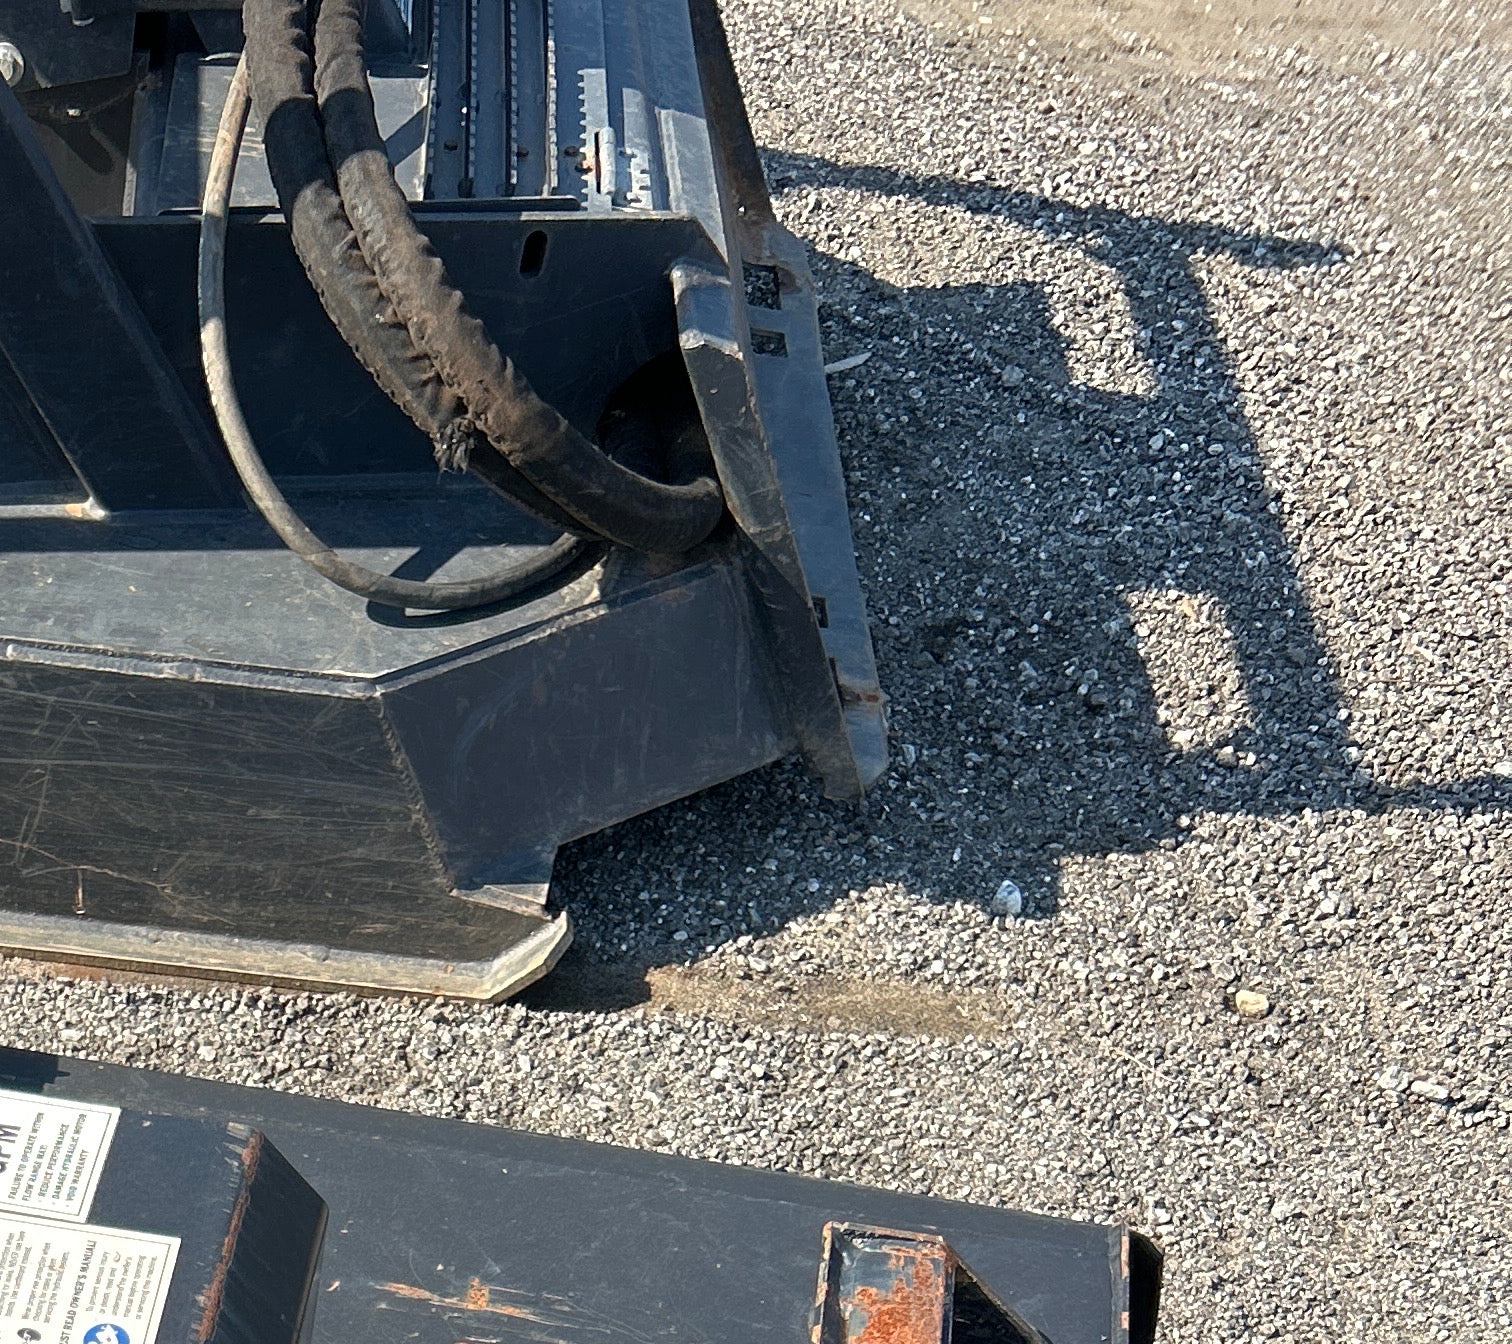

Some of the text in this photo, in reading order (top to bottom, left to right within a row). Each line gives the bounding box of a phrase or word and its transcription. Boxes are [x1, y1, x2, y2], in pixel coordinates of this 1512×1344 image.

[19, 1134, 36, 1162] OPERATE
[21, 1183, 35, 1201] FLOW
[62, 1309, 77, 1330] READ
